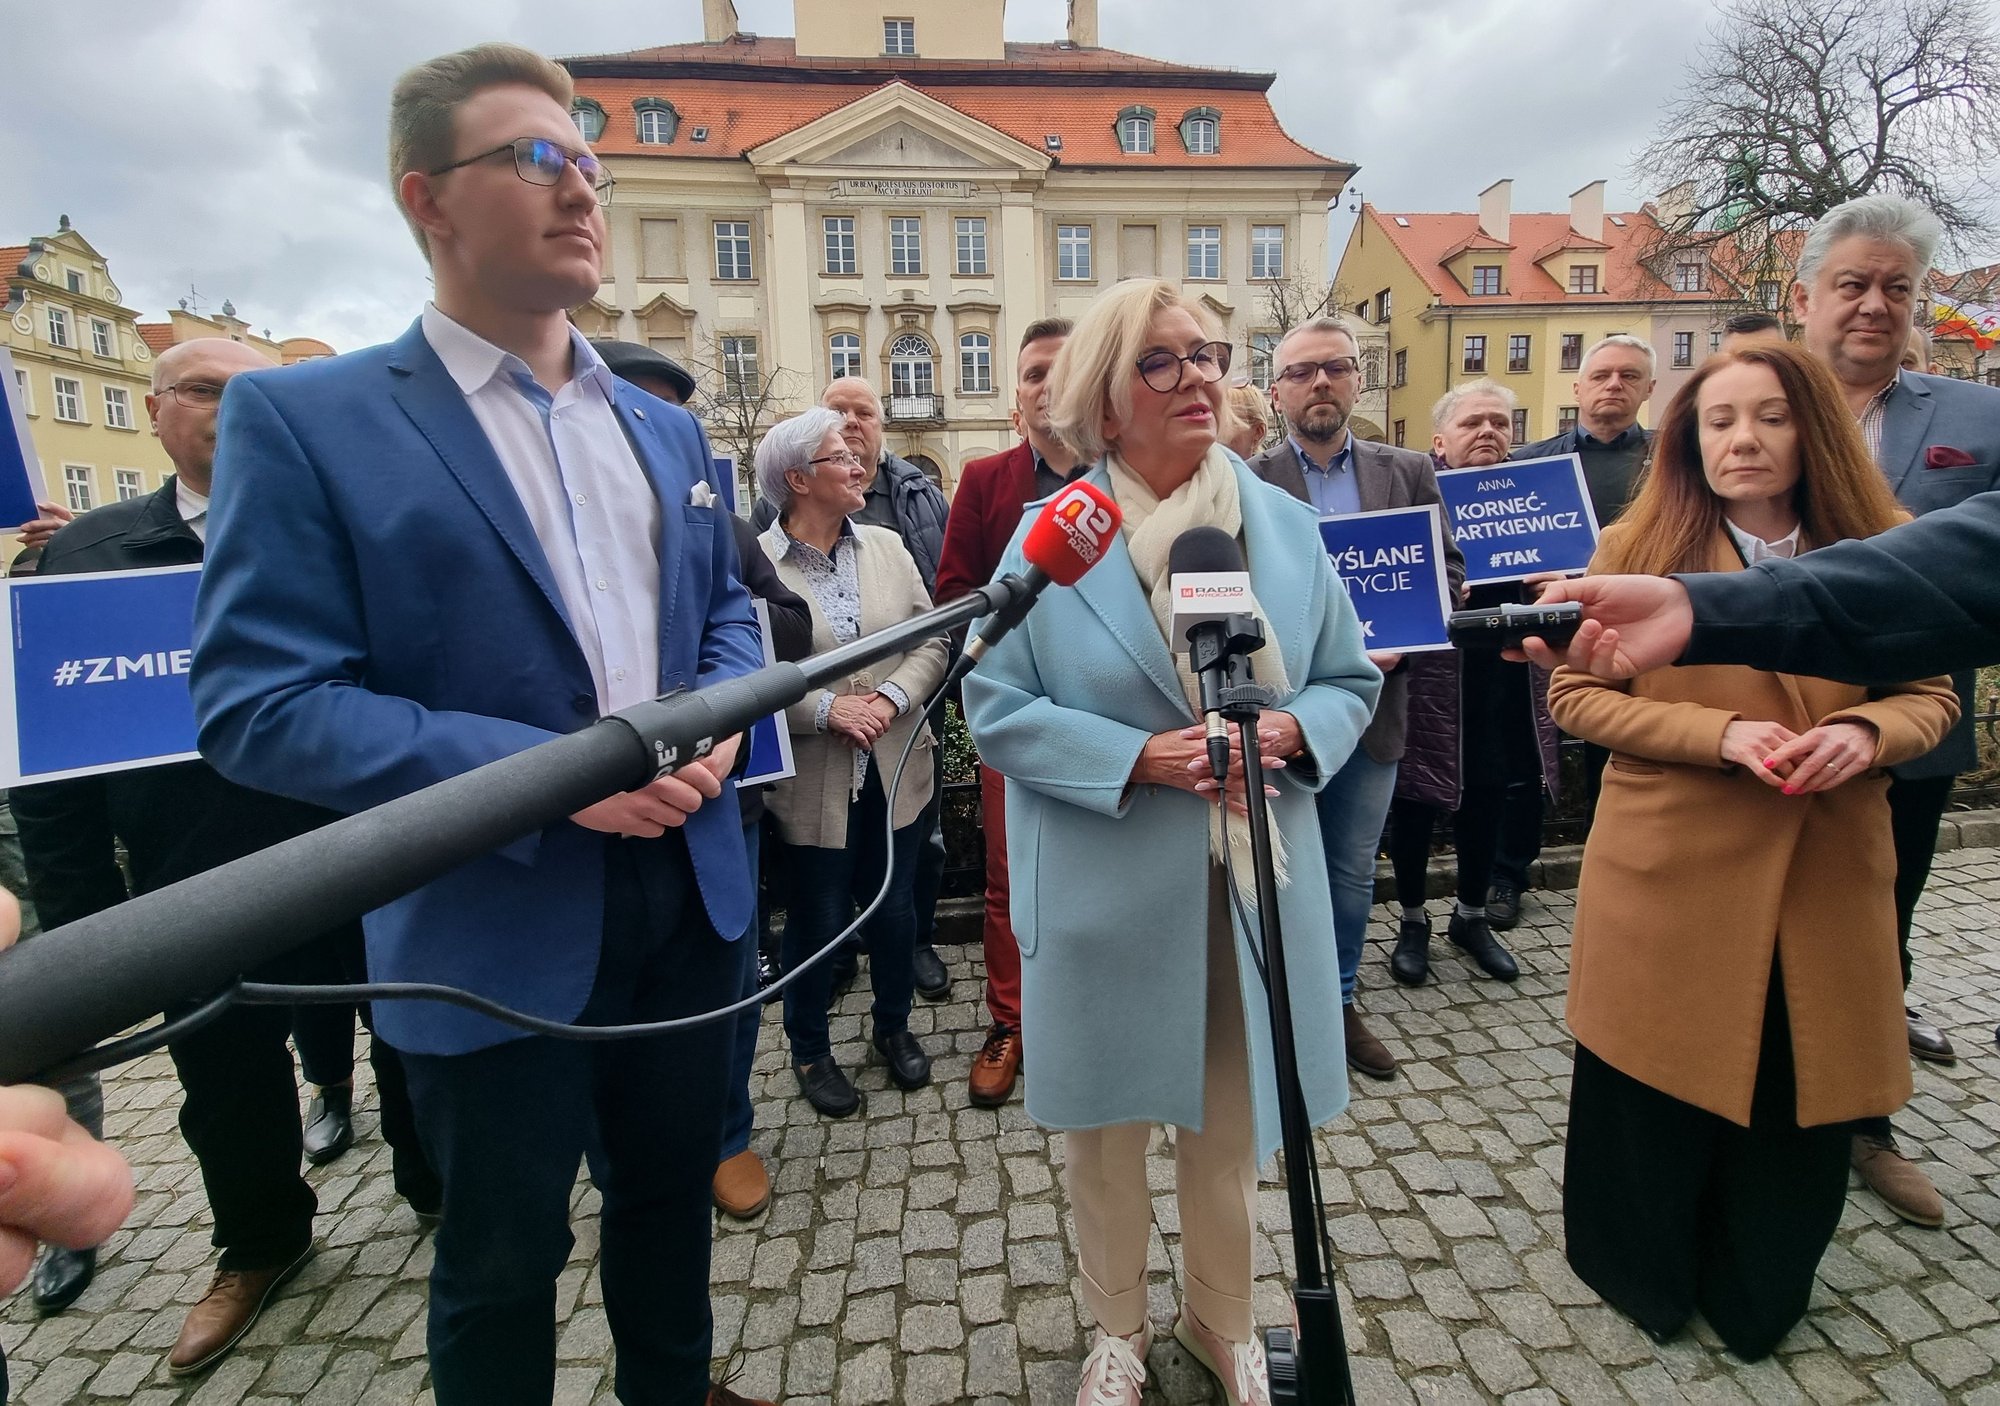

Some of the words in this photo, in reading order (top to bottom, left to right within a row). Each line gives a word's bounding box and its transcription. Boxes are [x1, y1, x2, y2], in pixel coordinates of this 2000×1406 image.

[849, 180, 874, 189] URBEM
[878, 180, 917, 190] BOLESLAUS
[920, 181, 959, 190] DISTORTUS
[903, 188, 933, 197] STRUXIT
[1477, 478, 1516, 492] ANNA
[1455, 491, 1547, 521] KORNEĆ-
[1052, 513, 1099, 557] MUZYCZNE
[1067, 537, 1094, 564] RADIO
[1327, 544, 1425, 571] YŚLANE
[1489, 548, 1542, 568] #TAK
[1340, 570, 1413, 594] TYCJE
[53, 648, 192, 687] #ZMIE
